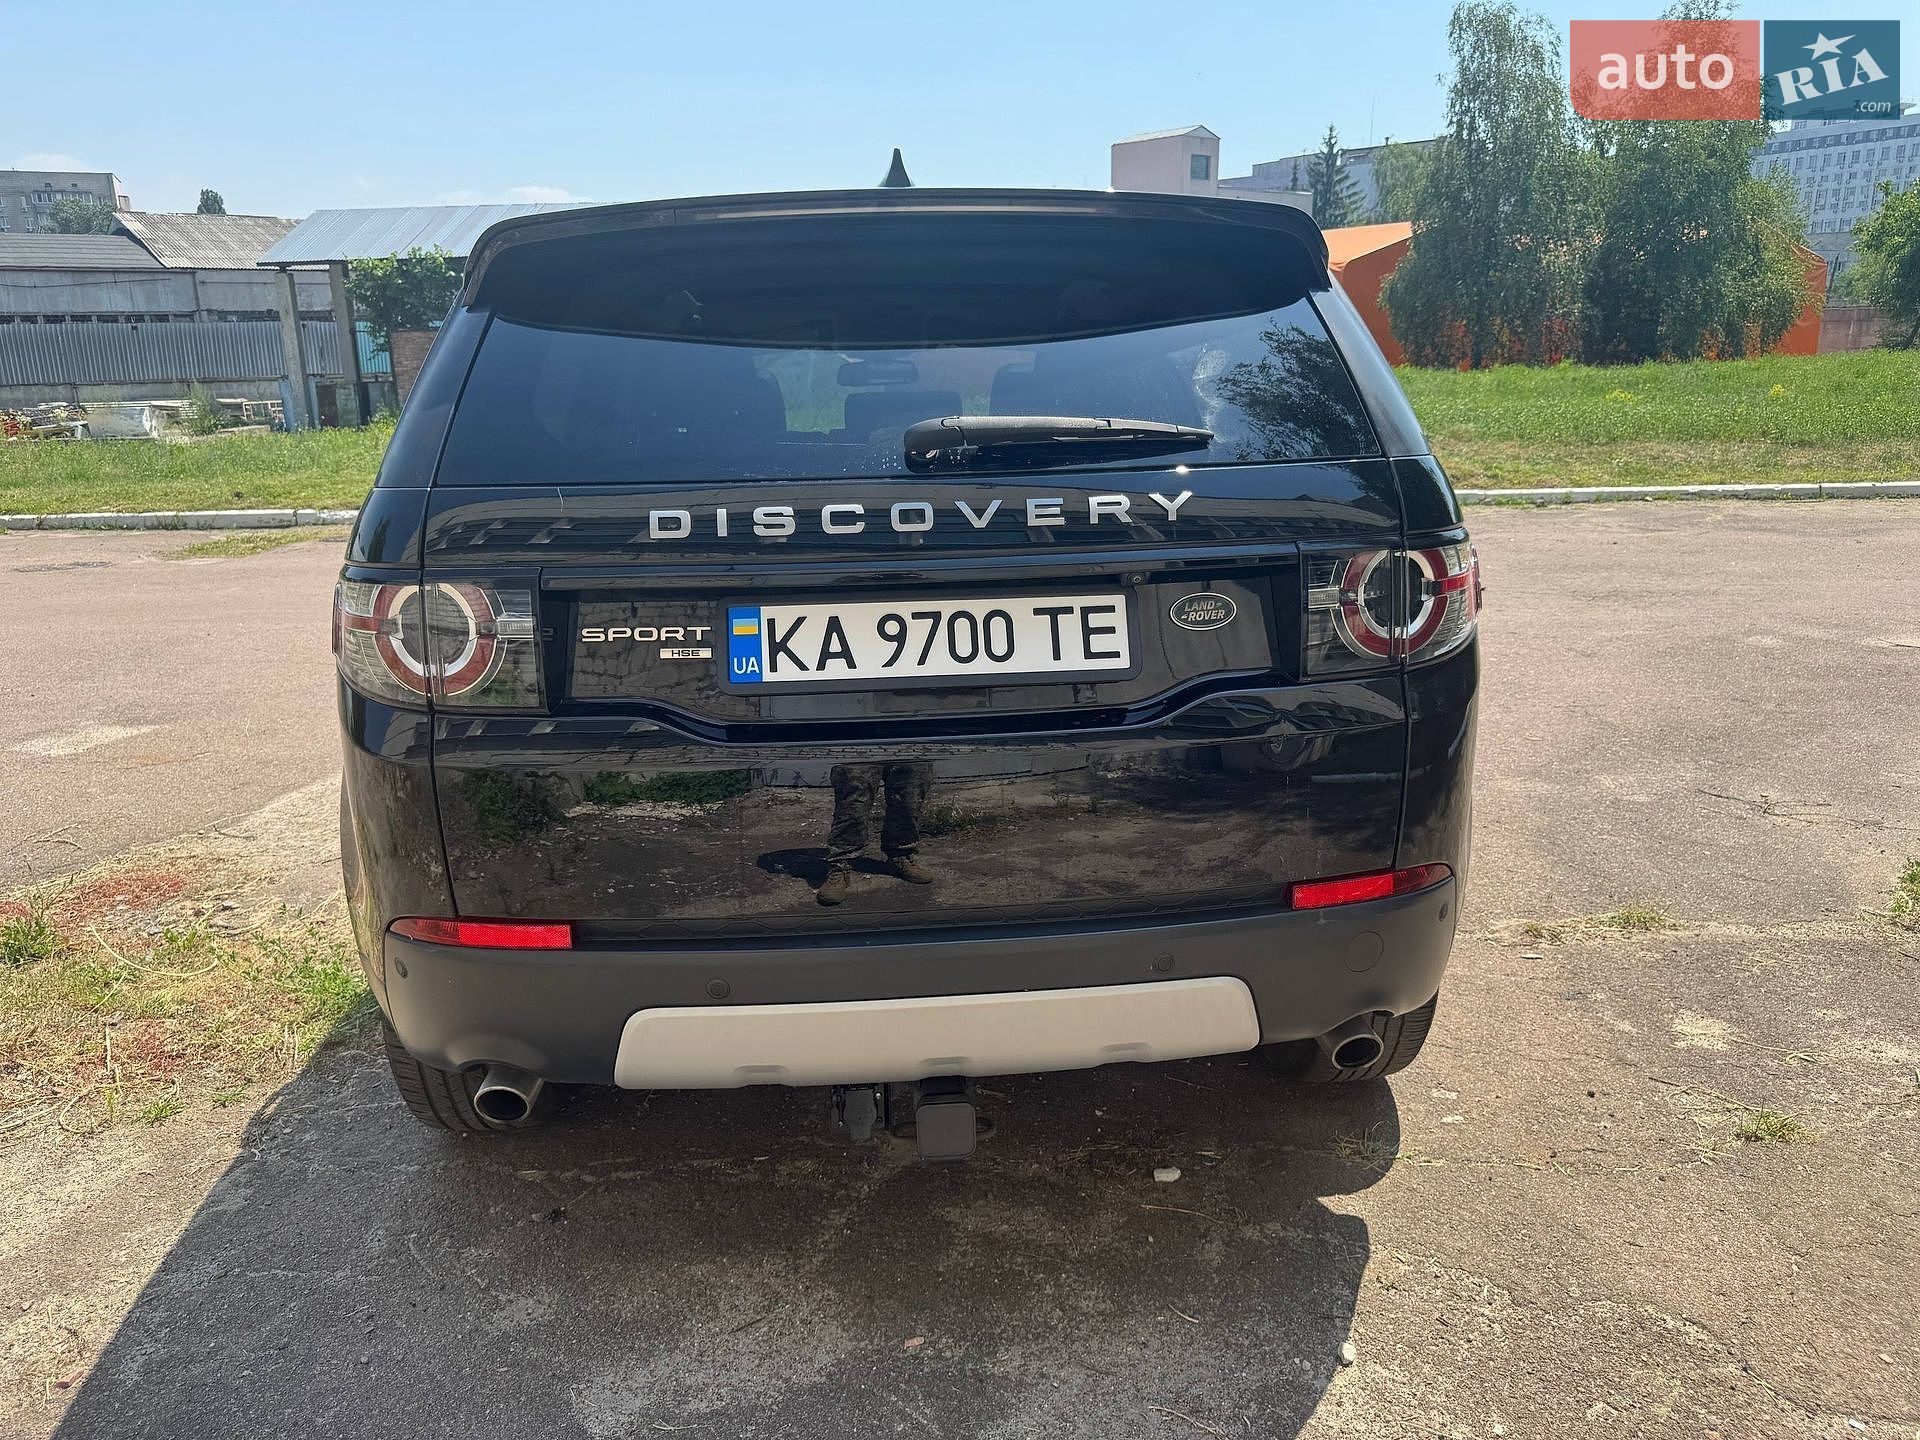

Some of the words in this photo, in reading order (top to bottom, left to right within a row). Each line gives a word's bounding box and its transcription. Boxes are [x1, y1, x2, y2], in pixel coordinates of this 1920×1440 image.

[649, 490, 1193, 538] DISCOVERY
[581, 626, 712, 642] SPORT
[766, 615, 858, 673] KA
[876, 609, 1016, 670] 9700
[1032, 605, 1122, 662] TE
[671, 649, 701, 657] HSE
[733, 657, 760, 674] UA
